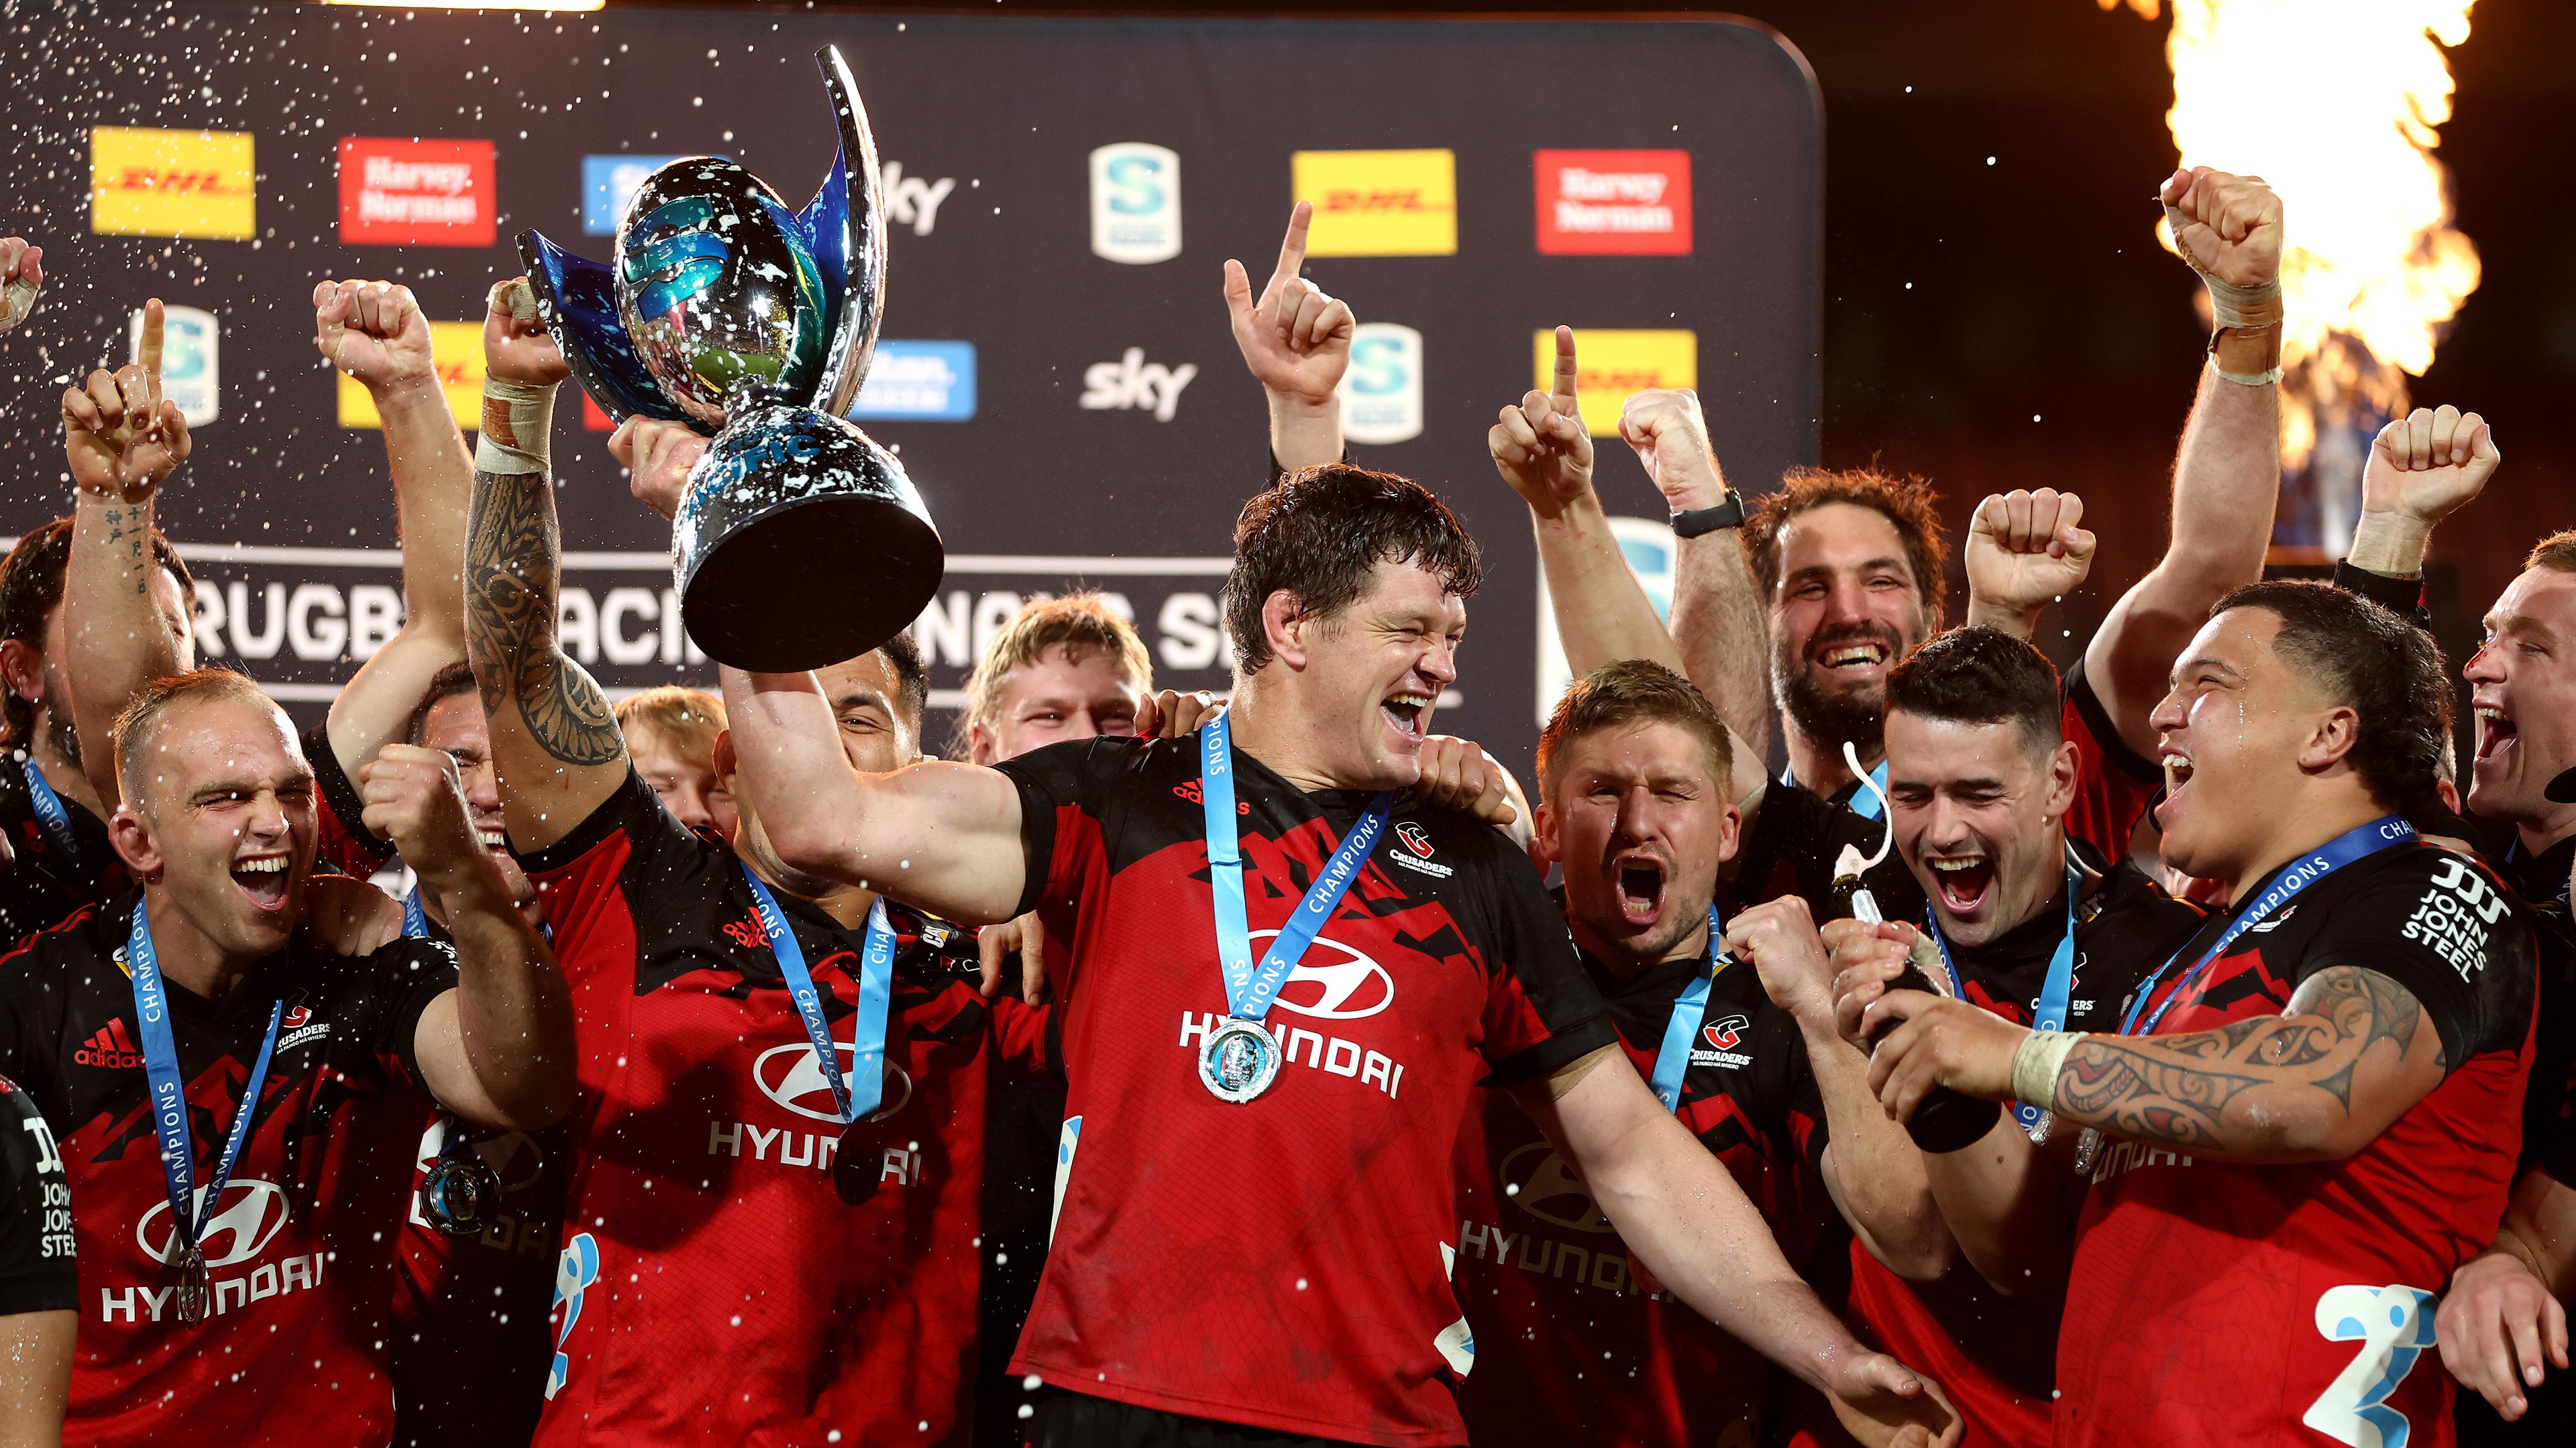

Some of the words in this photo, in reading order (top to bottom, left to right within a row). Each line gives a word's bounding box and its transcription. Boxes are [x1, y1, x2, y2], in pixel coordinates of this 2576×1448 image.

[359, 191, 478, 223] Norman
[363, 156, 472, 197] Harvey
[883, 162, 958, 236] ky
[1558, 168, 1668, 205] Harvey
[1554, 203, 1674, 233] Norman
[1079, 347, 1198, 422] sky
[686, 434, 822, 520] ACIFIC
[192, 579, 405, 661] RUGB
[1207, 718, 1226, 776] PIONS
[1173, 787, 1250, 816] ads
[1309, 814, 1378, 913] CHAMPIONS
[1389, 849, 1454, 876] CRUSADERS
[2215, 856, 2330, 953] CHAMPIONS
[2410, 905, 2487, 971] JONES
[2420, 889, 2488, 948] JOHN
[133, 902, 161, 1023] CHAMPIONS
[1242, 956, 1286, 1016] PIONS
[2402, 921, 2471, 983] STEEL
[278, 1023, 330, 1048] USADERS
[798, 989, 846, 1111] CHAMPIONS
[1179, 1011, 1405, 1100] HNDAI
[158, 1081, 191, 1216] CHAMPIONS
[201, 1091, 252, 1219] CHAMPIONS
[708, 1121, 922, 1187] HYUAI
[102, 1251, 323, 1323] HYNDAI
[1458, 1219, 1676, 1303] HYUND
